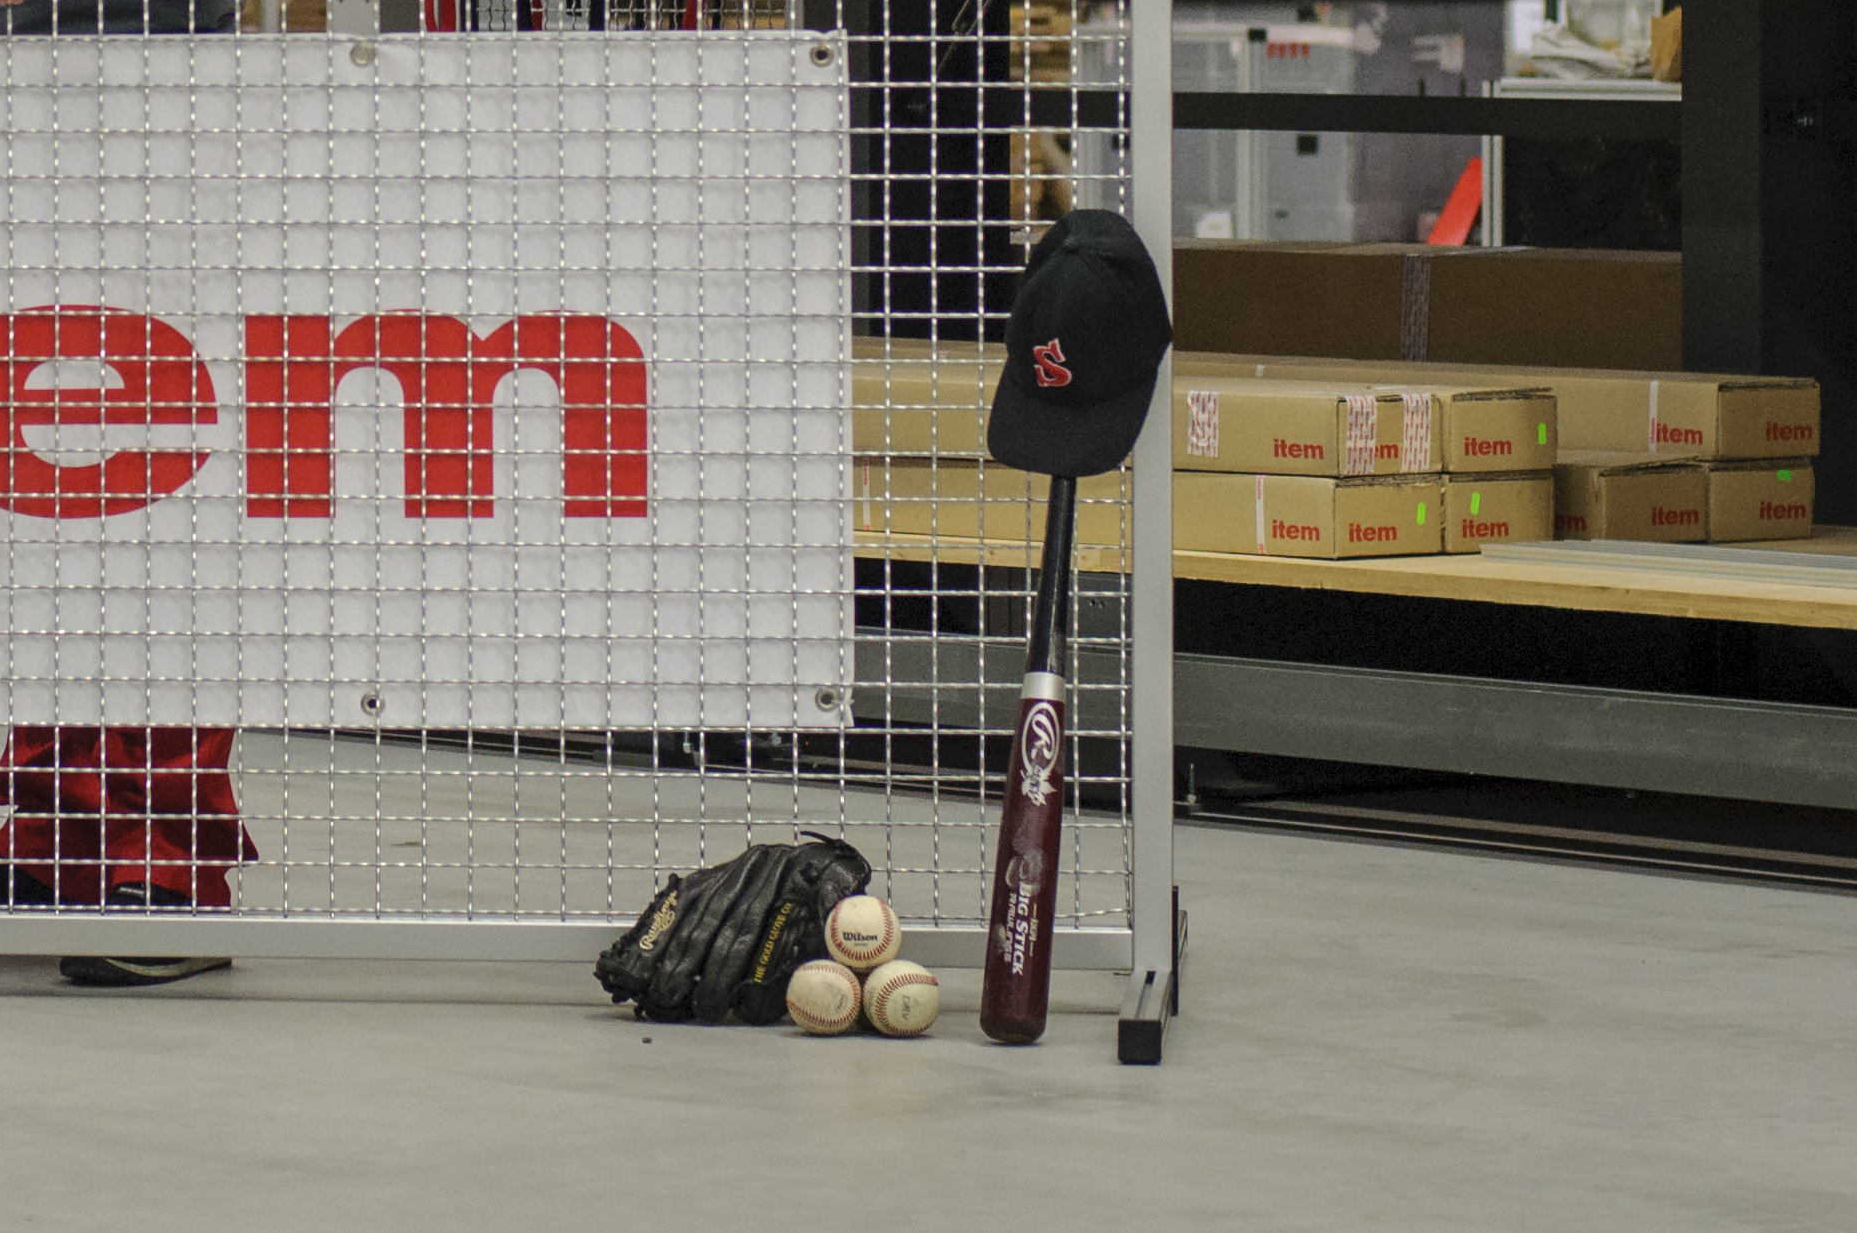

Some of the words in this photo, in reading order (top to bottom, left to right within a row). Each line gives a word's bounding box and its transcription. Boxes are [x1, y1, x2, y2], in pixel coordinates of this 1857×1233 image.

[1033, 338, 1073, 387] S
[1656, 422, 1704, 446] item
[1765, 422, 1814, 442] item
[1274, 438, 1325, 460] item
[1463, 436, 1513, 457] item
[1650, 506, 1700, 526] item
[1759, 500, 1807, 521] item
[1271, 519, 1321, 542] item
[1348, 523, 1398, 543] item
[1461, 519, 1510, 539] item
[842, 931, 879, 943] Wilson
[1011, 919, 1030, 977] STICK
